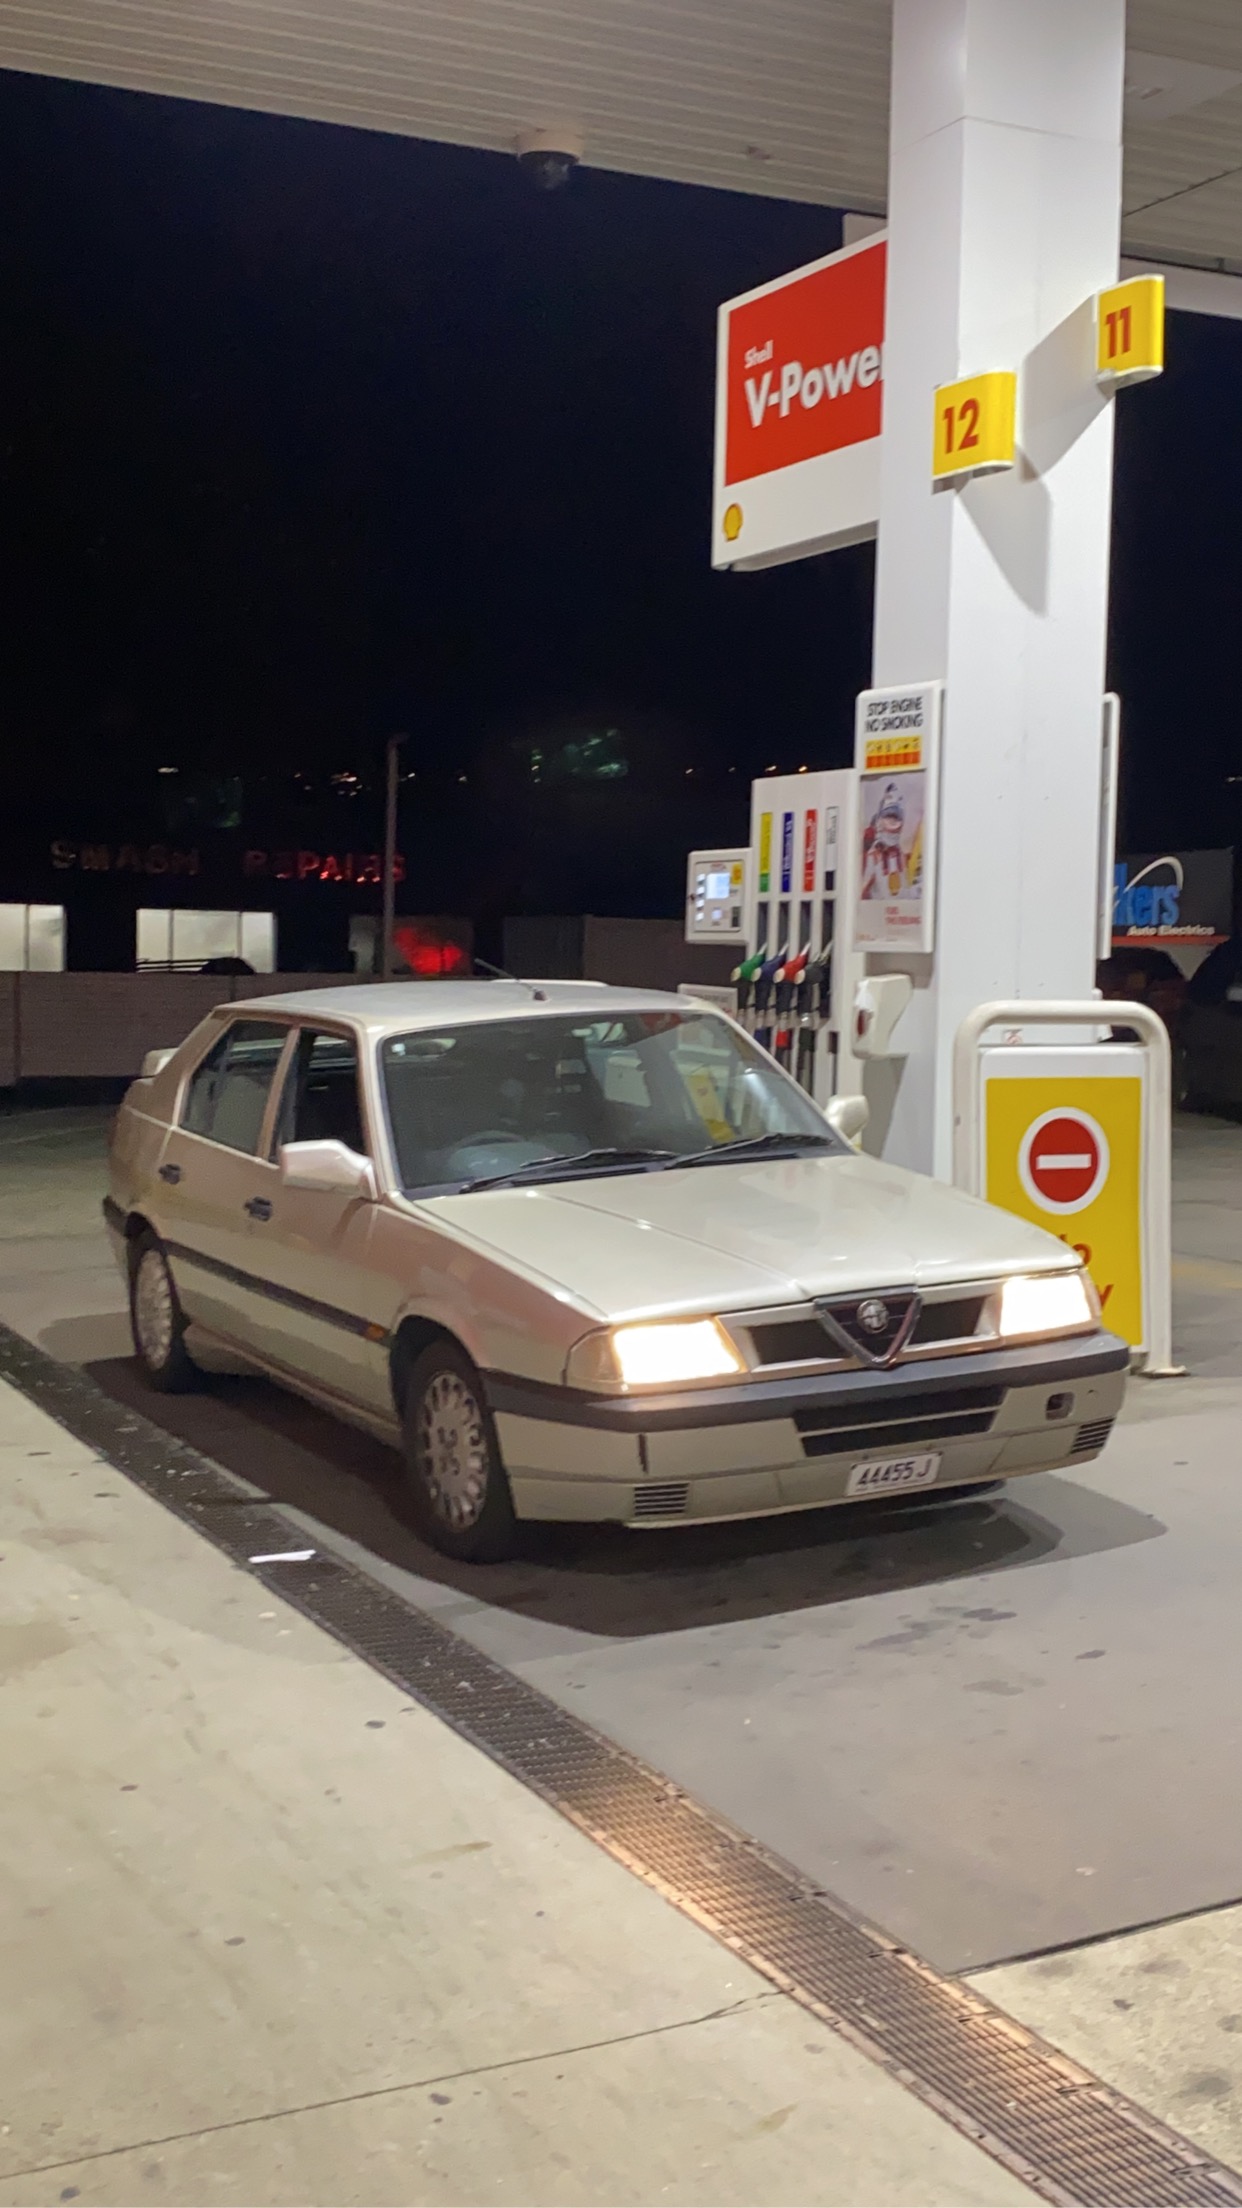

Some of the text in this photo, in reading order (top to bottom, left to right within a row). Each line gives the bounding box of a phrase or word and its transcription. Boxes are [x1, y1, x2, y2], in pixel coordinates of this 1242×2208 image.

[1104, 305, 1132, 359] 11
[744, 339, 774, 369] Shell
[744, 344, 884, 428] V-Powe
[942, 397, 980, 455] 12
[864, 712, 924, 732] NO SMOKING
[867, 696, 923, 717] STOP ENGINE
[49, 840, 201, 876] SMASH
[1127, 926, 1157, 936] Auto
[1058, 1233, 1092, 1266] o
